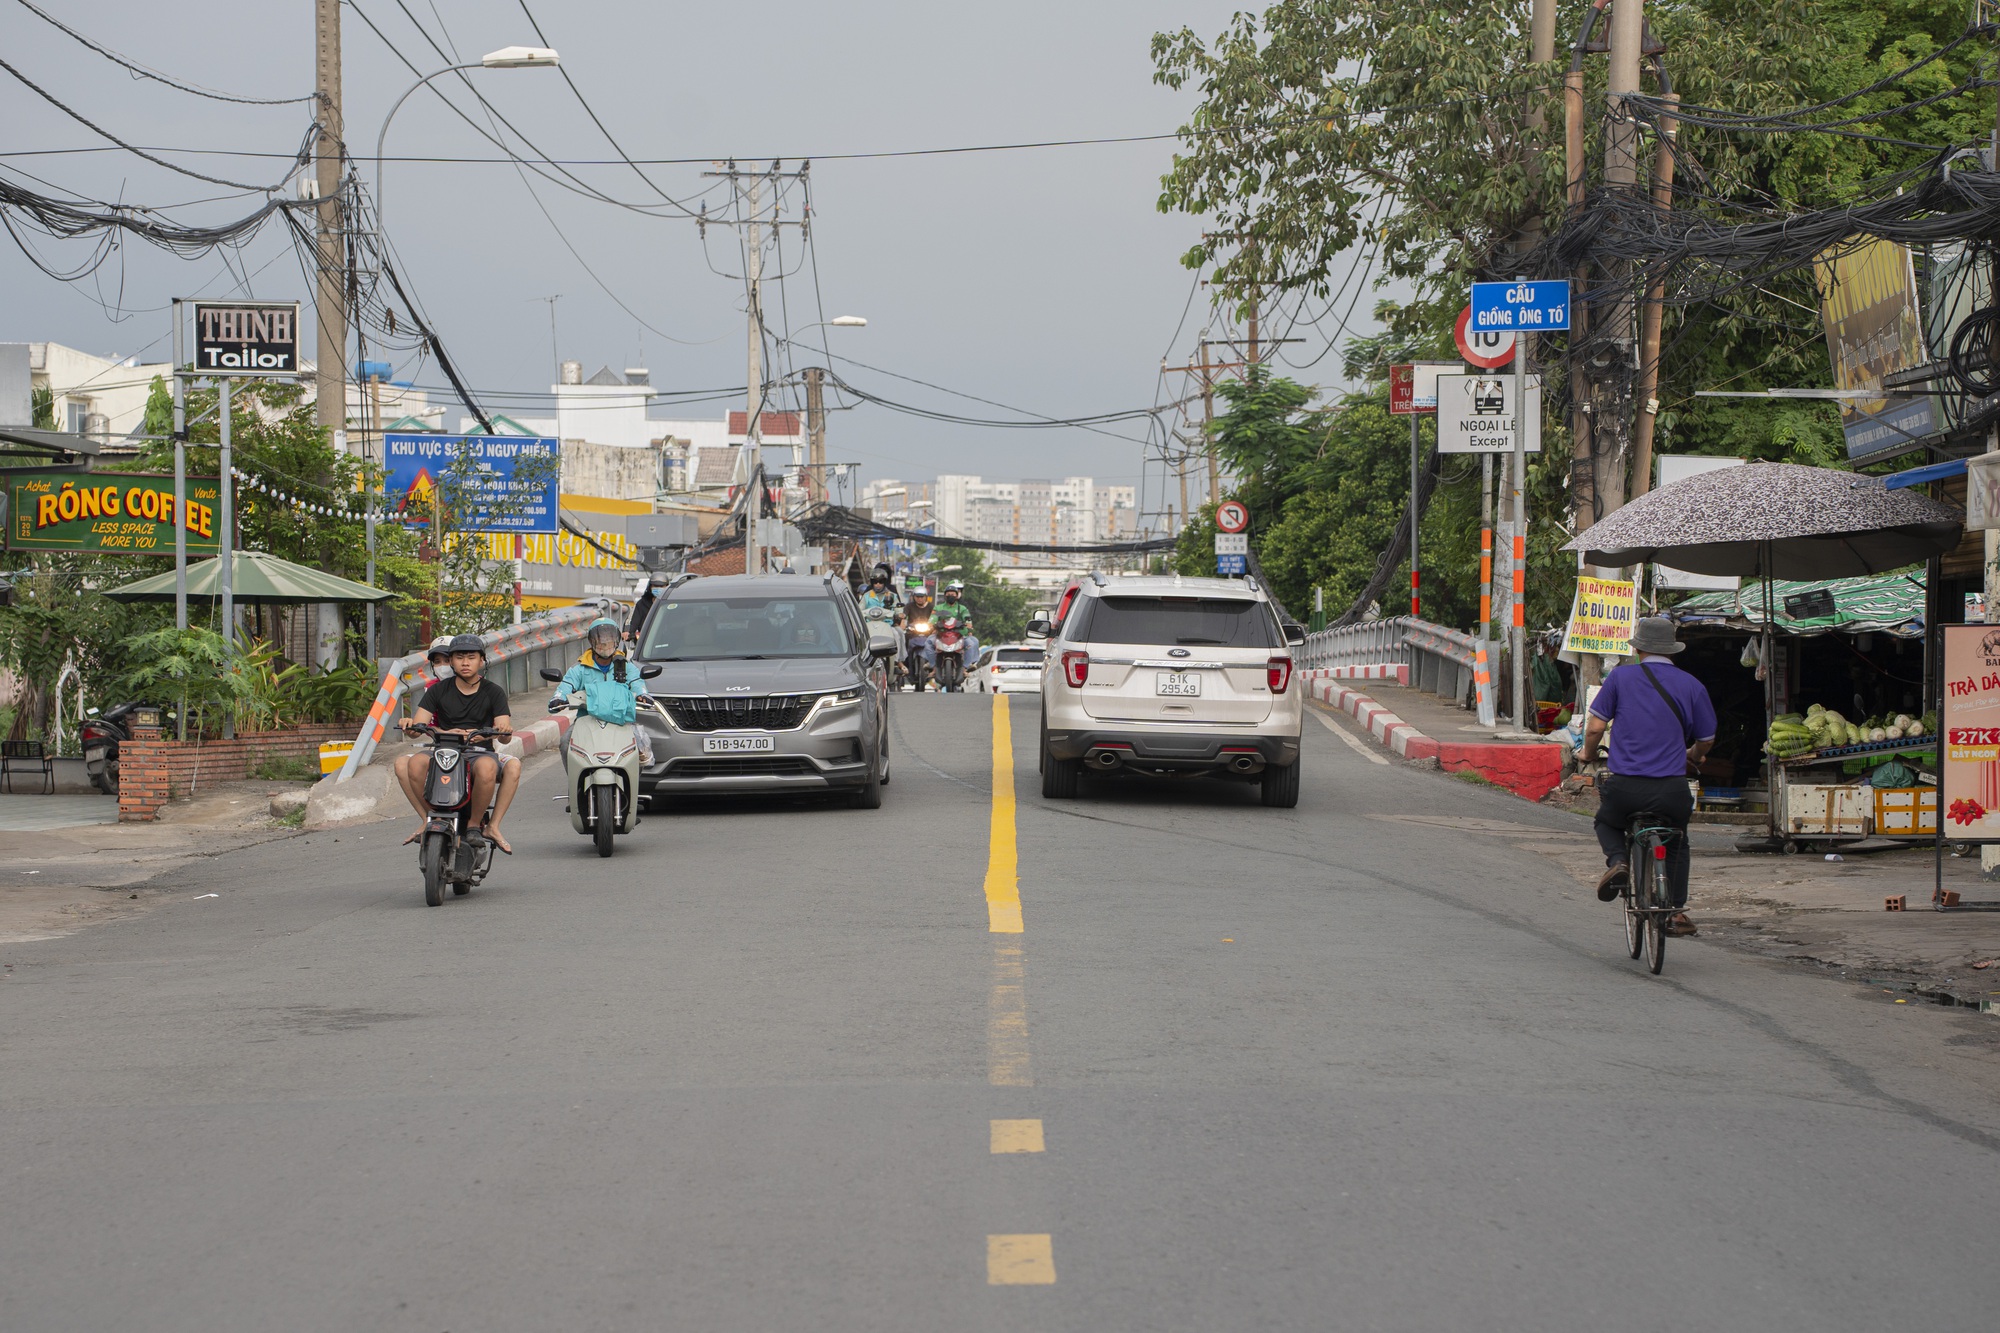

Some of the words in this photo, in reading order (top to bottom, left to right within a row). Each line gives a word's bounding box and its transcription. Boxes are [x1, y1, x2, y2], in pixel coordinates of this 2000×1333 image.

[1505, 283, 1535, 304] CẦU
[1478, 306, 1512, 325] GIỒNG
[1519, 306, 1542, 325] ÔNG
[1547, 303, 1565, 323] TỐ
[204, 347, 288, 368] Tailor
[1460, 420, 1499, 434] NGOẠI
[391, 441, 416, 456] KHU
[418, 439, 442, 459] VỰC
[486, 443, 519, 458] NGUY
[1469, 435, 1509, 449] Except
[24, 479, 52, 493] Achat
[194, 486, 217, 500] Vente
[21, 522, 31, 530] 20
[91, 522, 119, 534] LESS
[120, 523, 156, 535] SPACE
[100, 536, 132, 548] MORE
[135, 537, 157, 548] YOU
[1589, 582, 1604, 594] ĐÂY
[1605, 584, 1616, 596] CÓ
[1617, 585, 1633, 598] BÁN
[1590, 599, 1604, 619] ĐỦ
[1606, 604, 1630, 624] LOẠI
[1582, 638, 1600, 650] 0938
[1600, 640, 1614, 650] 586
[1615, 641, 1629, 651] 135
[1170, 674, 1188, 684] 61K
[1161, 684, 1196, 695] 295.49
[1948, 676, 1978, 697] TRÀ
[1957, 730, 1992, 744] 27K
[709, 739, 769, 750] 51B-947.00
[1951, 746, 1970, 758] RẤT
